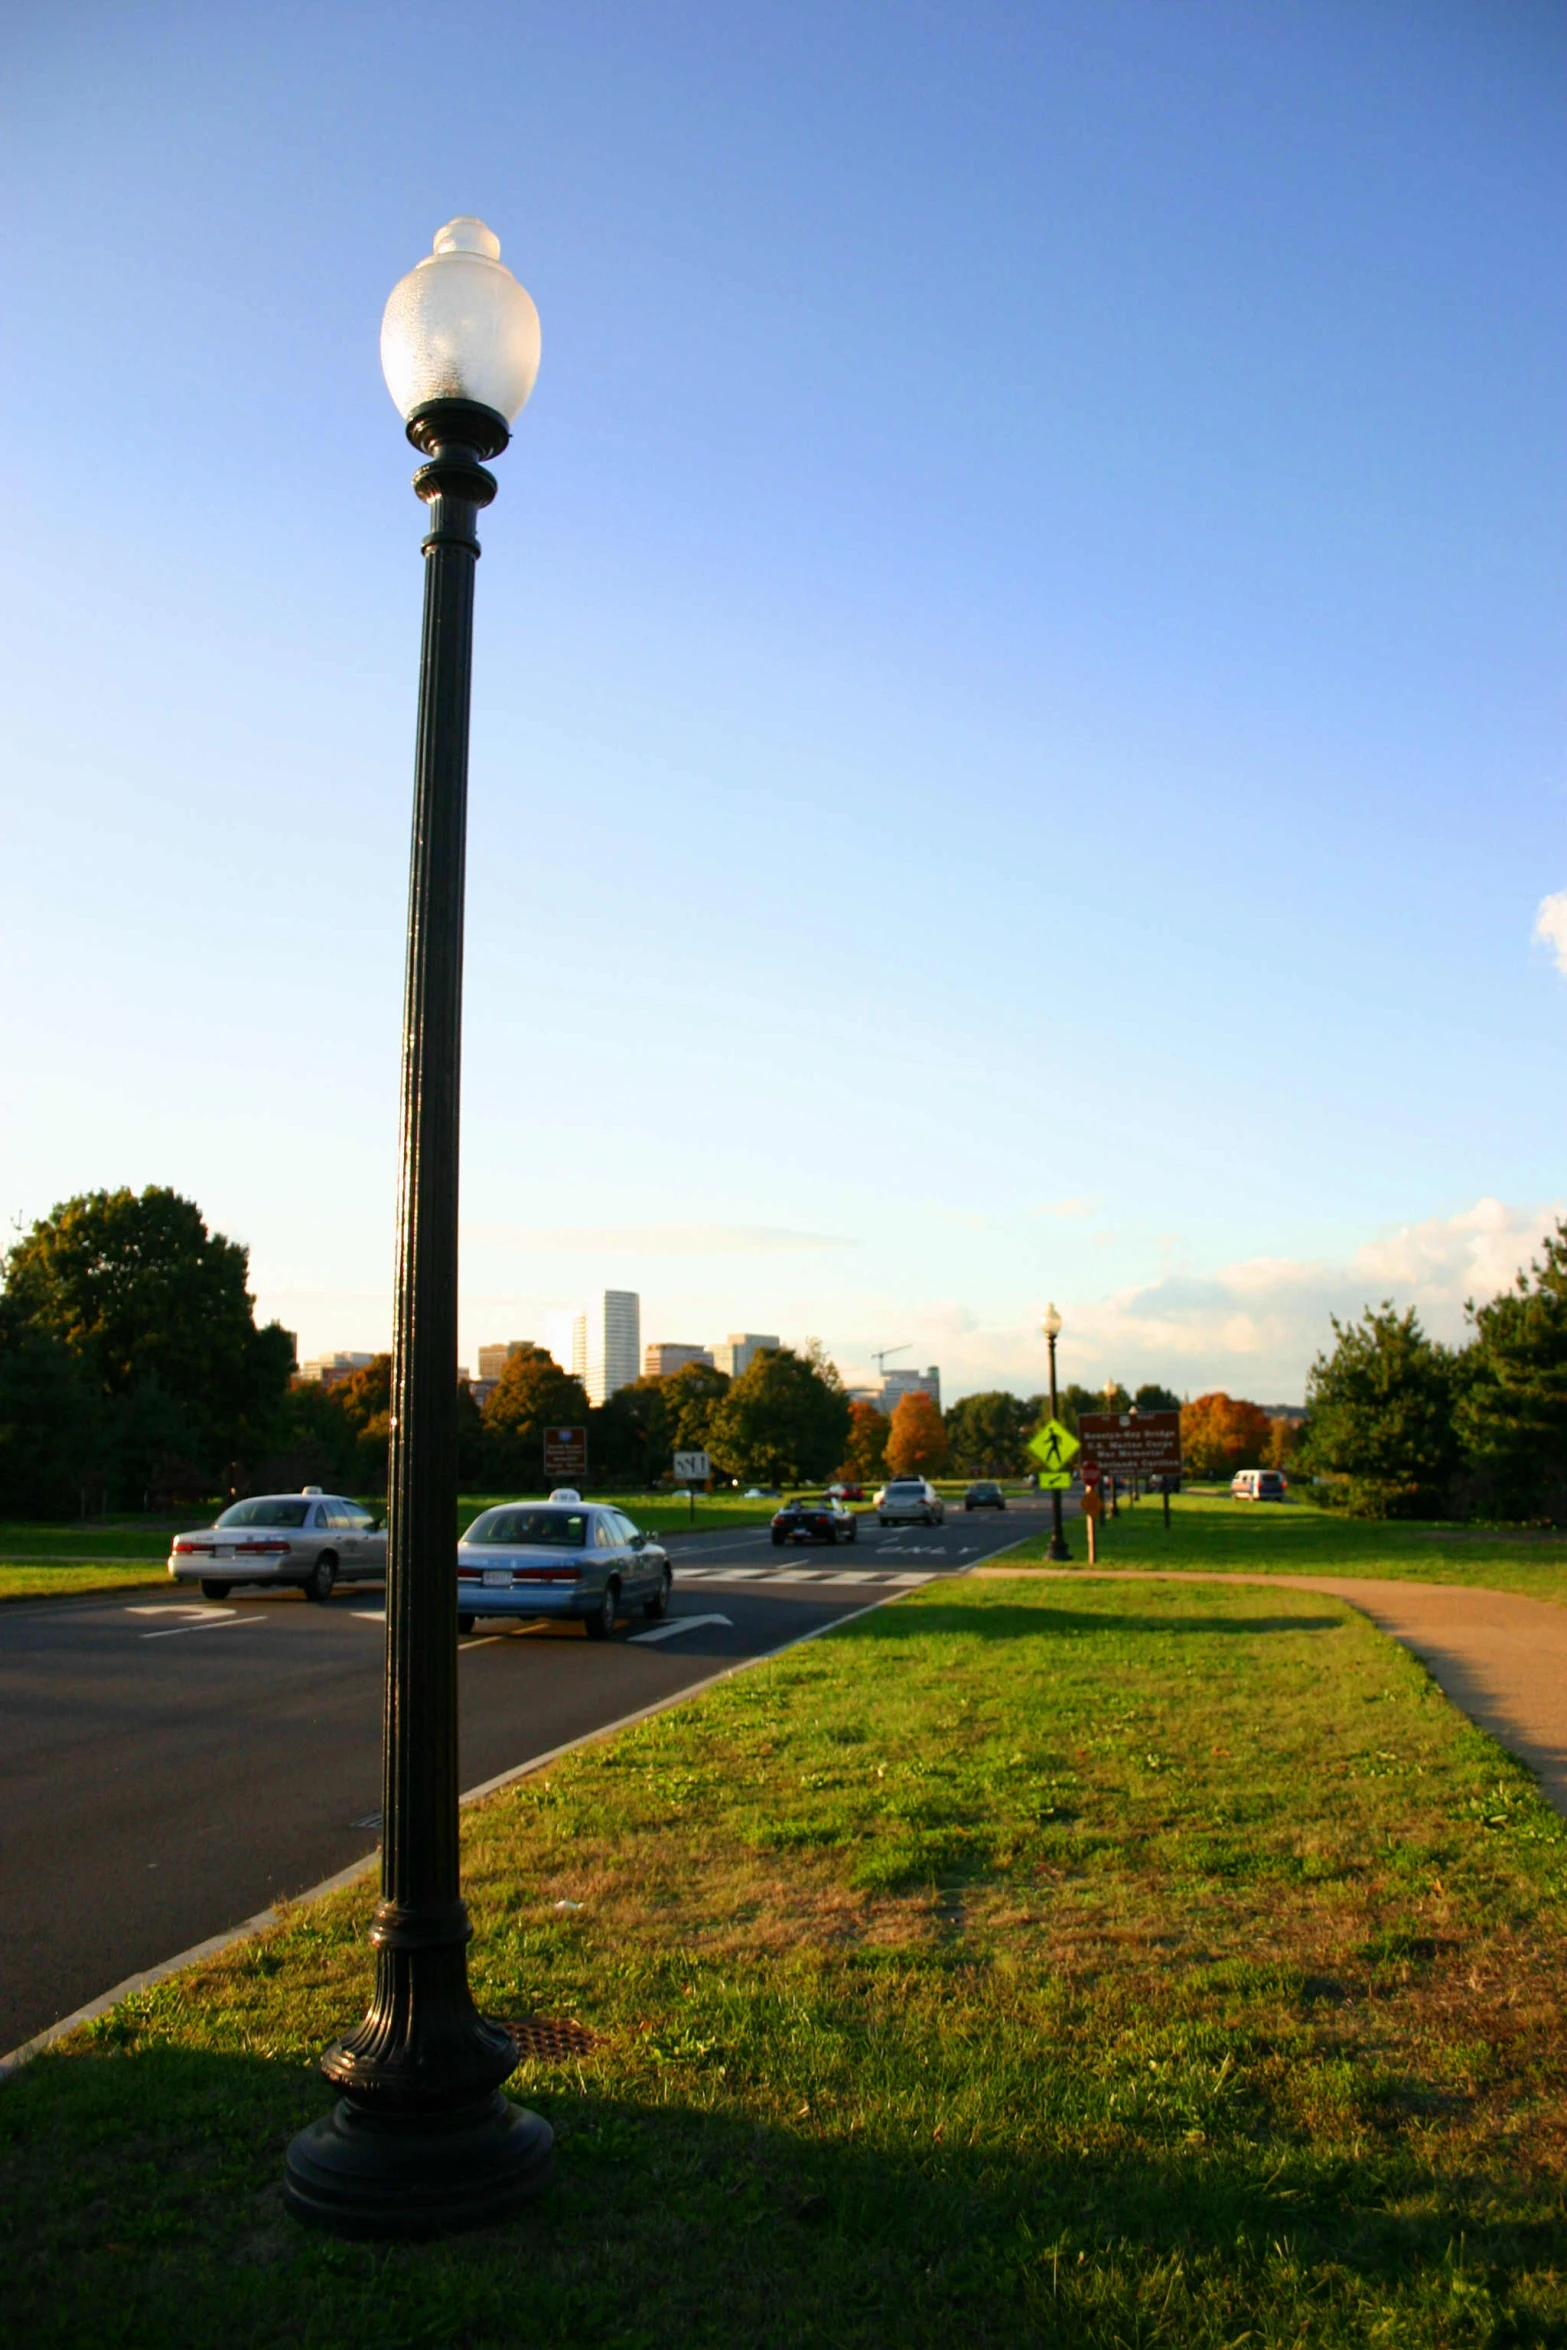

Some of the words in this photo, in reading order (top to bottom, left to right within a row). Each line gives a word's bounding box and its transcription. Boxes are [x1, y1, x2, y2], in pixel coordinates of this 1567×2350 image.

[1143, 1429, 1176, 1439] Bridge
[1109, 1440, 1143, 1449] Marine
[1145, 1439, 1174, 1449] Corps
[1118, 1449, 1164, 1458] Memorial
[875, 1545, 980, 1555] ONLY
